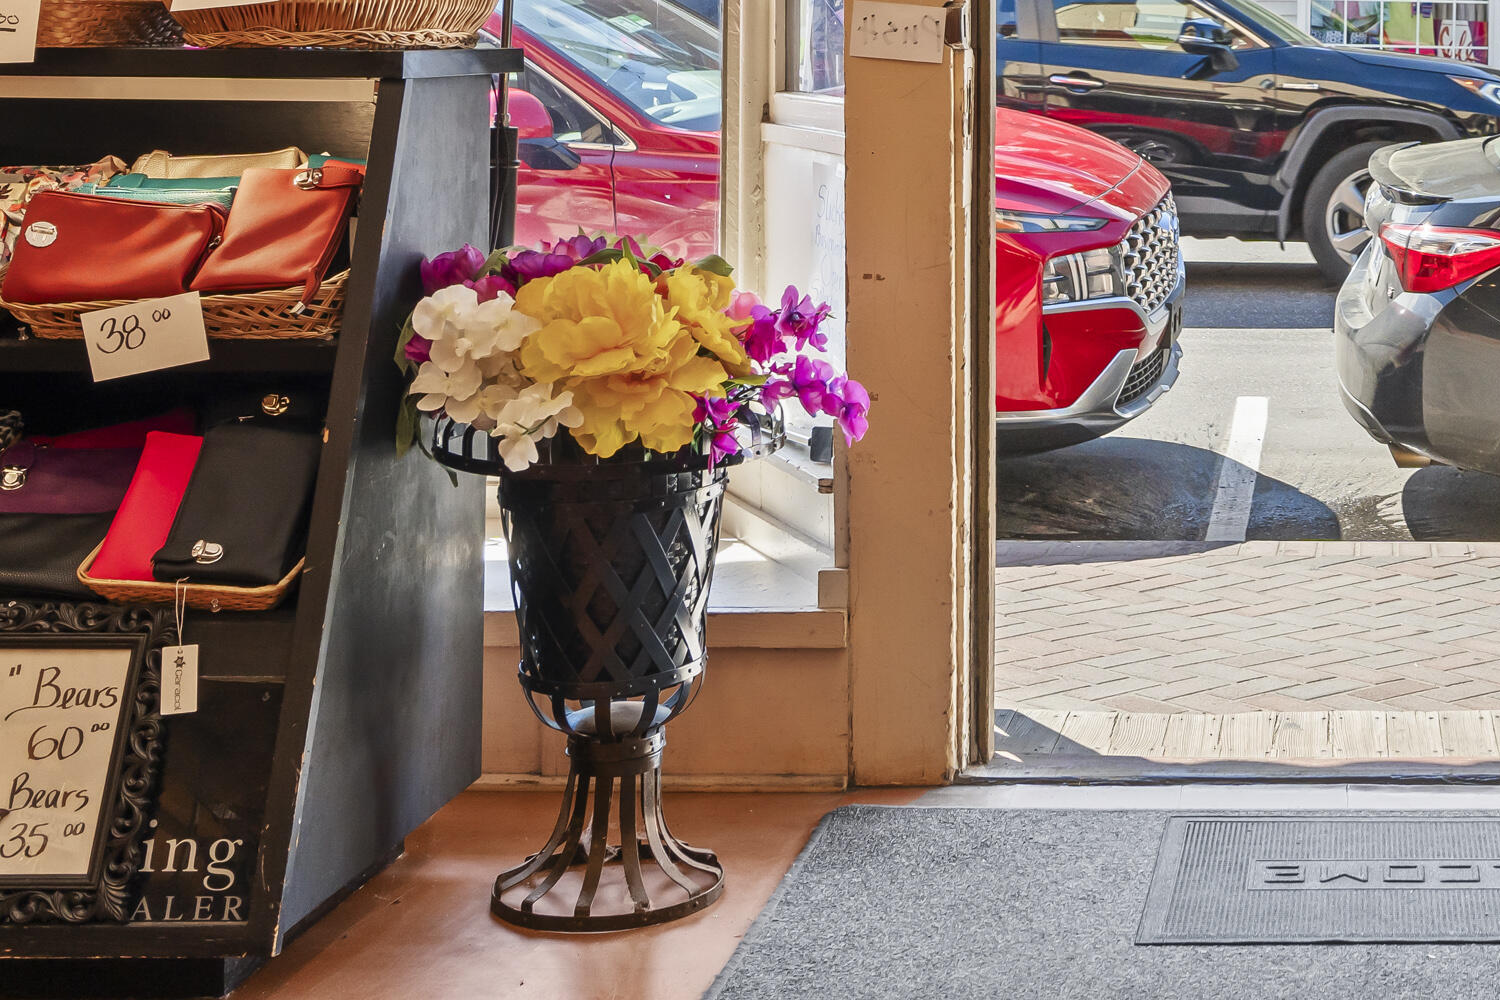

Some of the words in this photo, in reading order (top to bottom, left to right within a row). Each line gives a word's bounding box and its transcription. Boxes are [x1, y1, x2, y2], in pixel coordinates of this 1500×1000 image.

[96, 314, 146, 354] 38
[152, 307, 172, 322] 00
[30, 666, 118, 711] Bears
[28, 725, 84, 760] 60
[8, 772, 90, 812] Bears
[0, 822, 50, 859] 35
